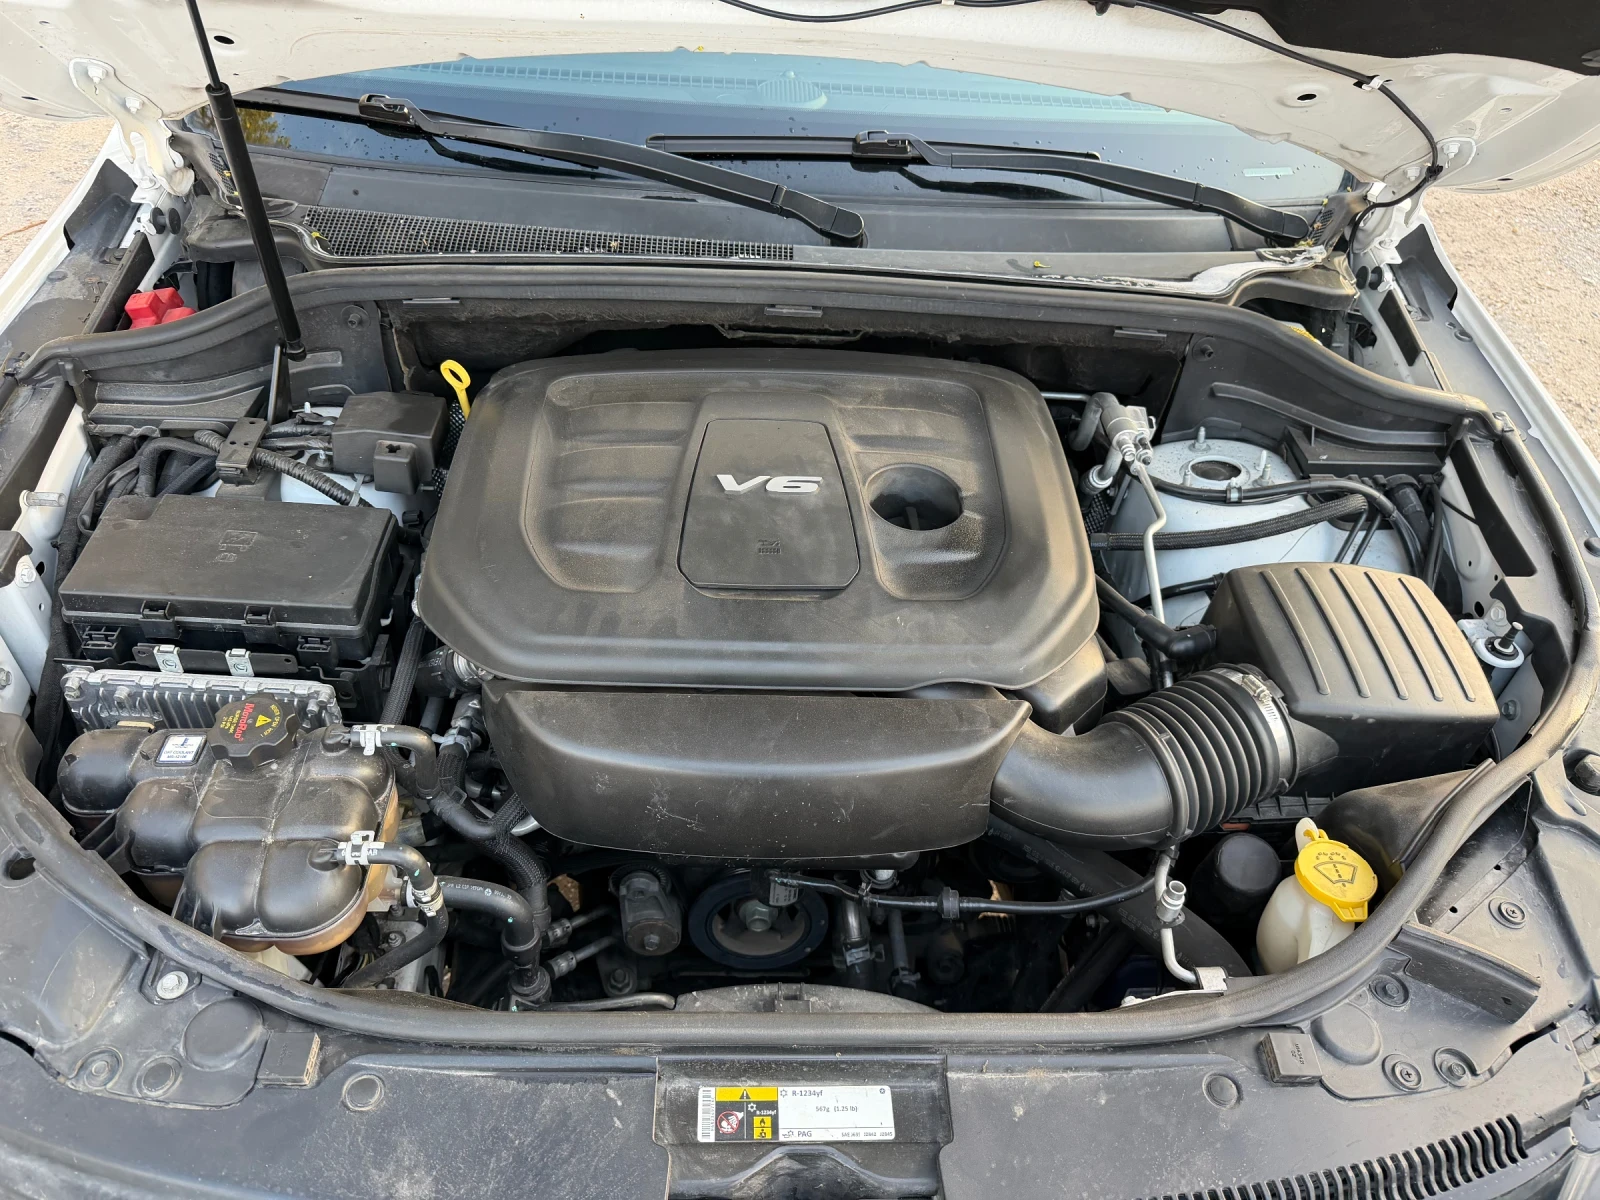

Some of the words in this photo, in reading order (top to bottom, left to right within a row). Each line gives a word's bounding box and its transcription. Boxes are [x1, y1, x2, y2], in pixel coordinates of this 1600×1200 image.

[716, 474, 823, 495] V6
[272, 716, 280, 728] OPEN
[264, 728, 274, 736] HOT
